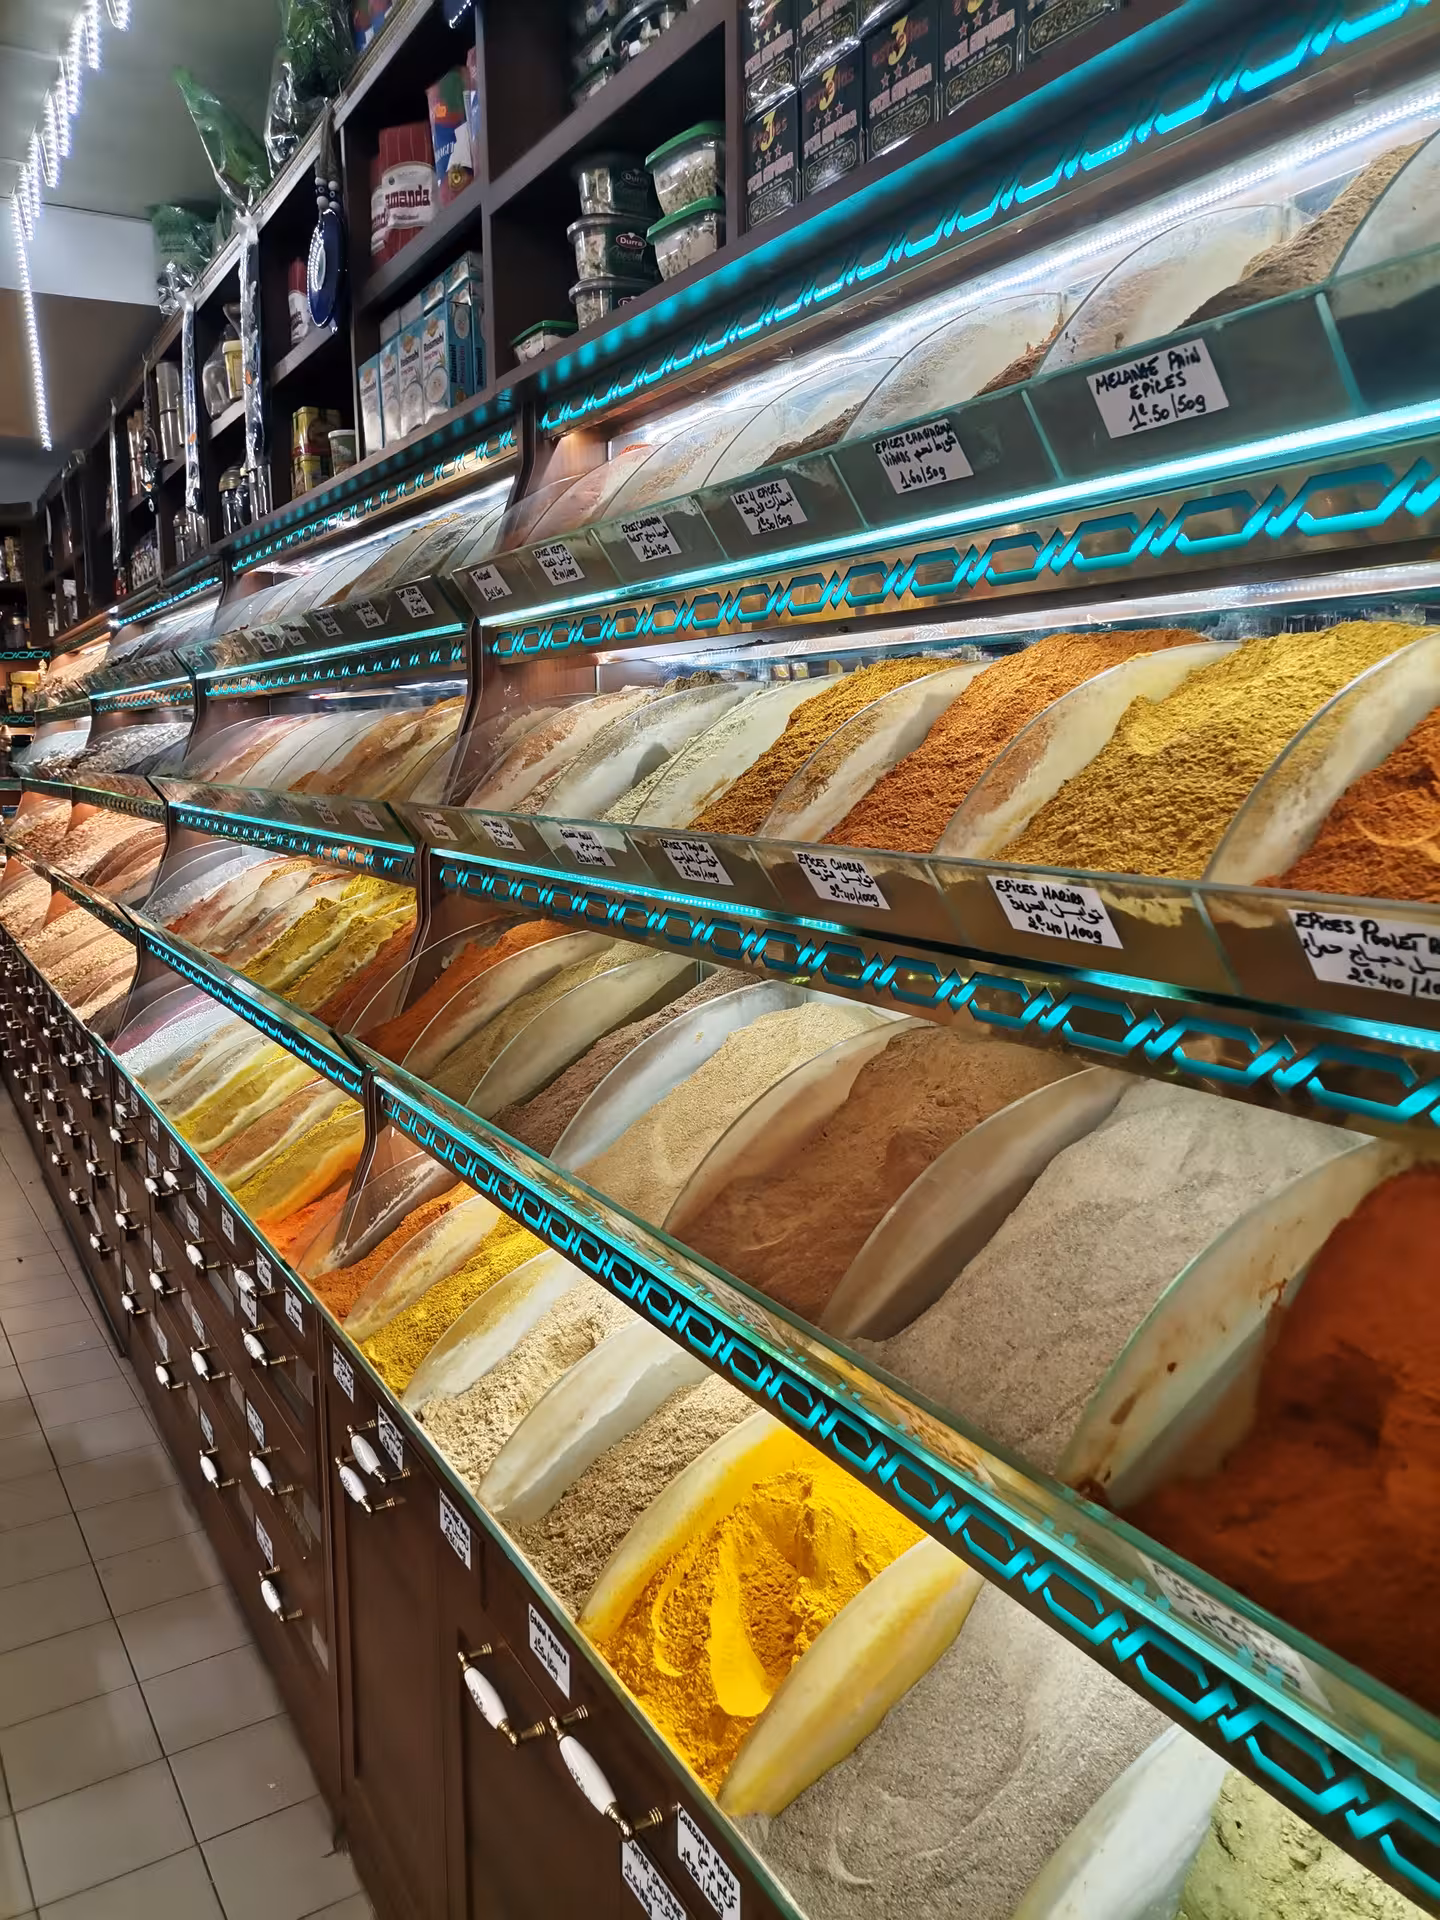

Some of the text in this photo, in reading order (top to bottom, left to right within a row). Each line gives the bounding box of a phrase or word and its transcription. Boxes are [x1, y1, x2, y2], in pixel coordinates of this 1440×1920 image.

[887, 15, 908, 65] 3
[818, 65, 837, 111] 3
[761, 111, 776, 152] 3
[385, 184, 431, 209] amanda
[620, 236, 643, 248] Durra
[1095, 355, 1160, 396] MELANGE
[829, 858, 866, 874] CHORBA
